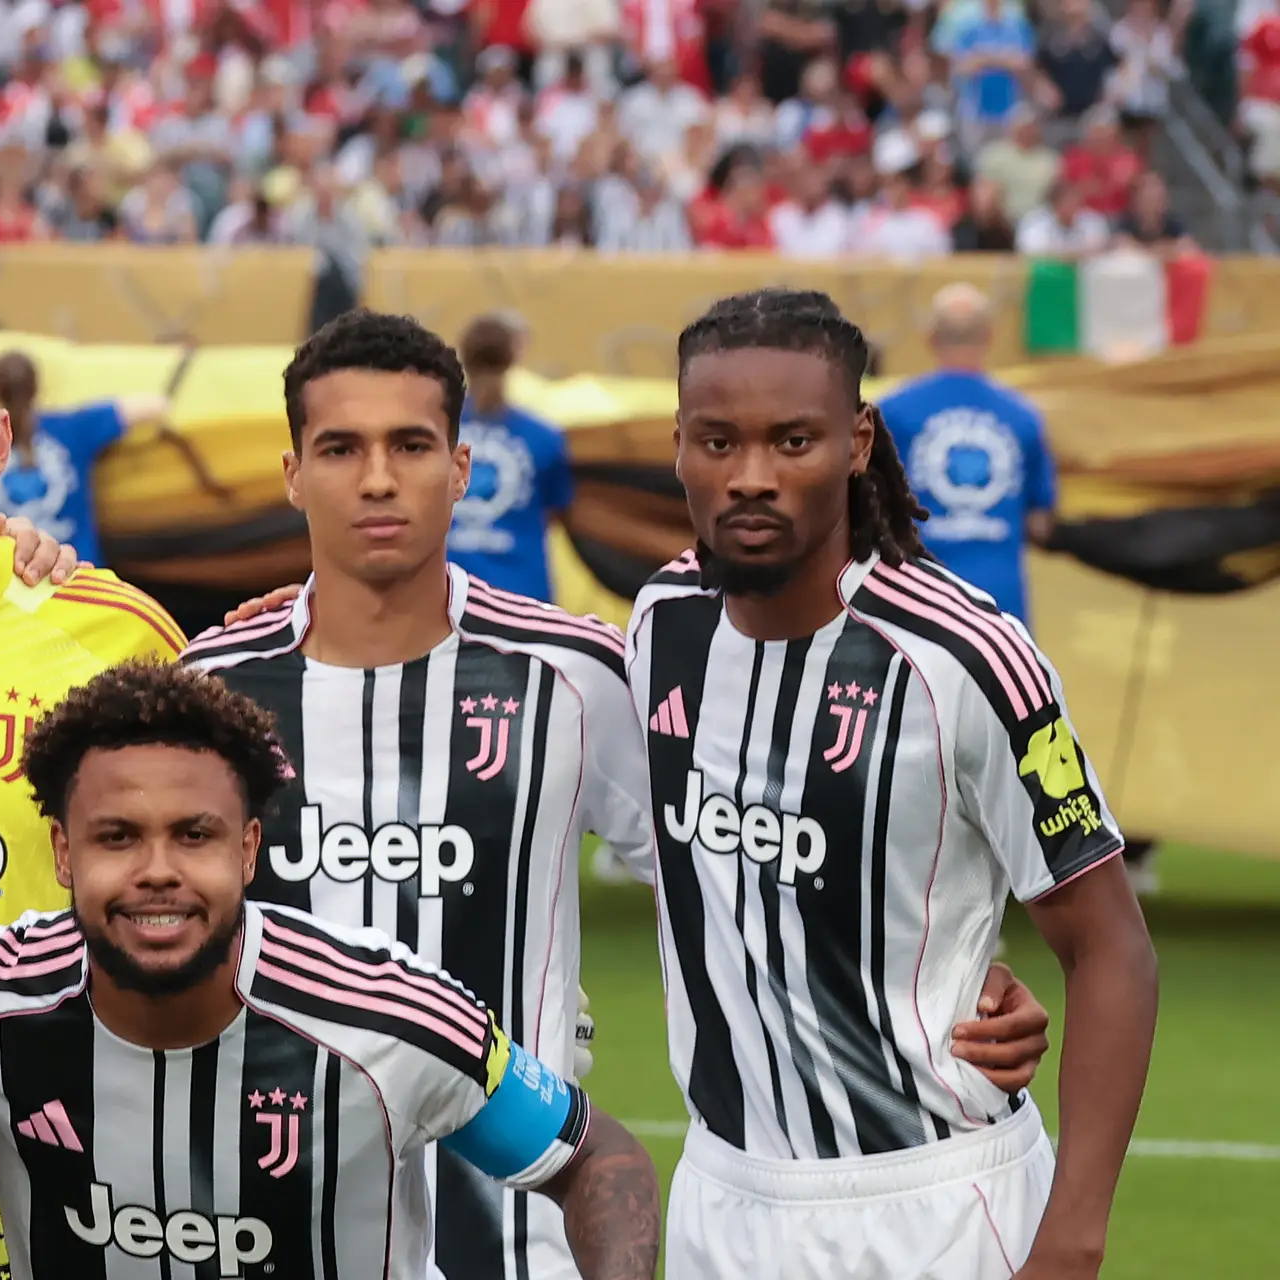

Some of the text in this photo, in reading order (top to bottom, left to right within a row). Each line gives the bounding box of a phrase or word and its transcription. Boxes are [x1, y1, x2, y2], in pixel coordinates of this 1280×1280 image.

[268, 803, 476, 898] Jeep
[662, 769, 827, 886] Jeep
[62, 1181, 273, 1278] Jeep
